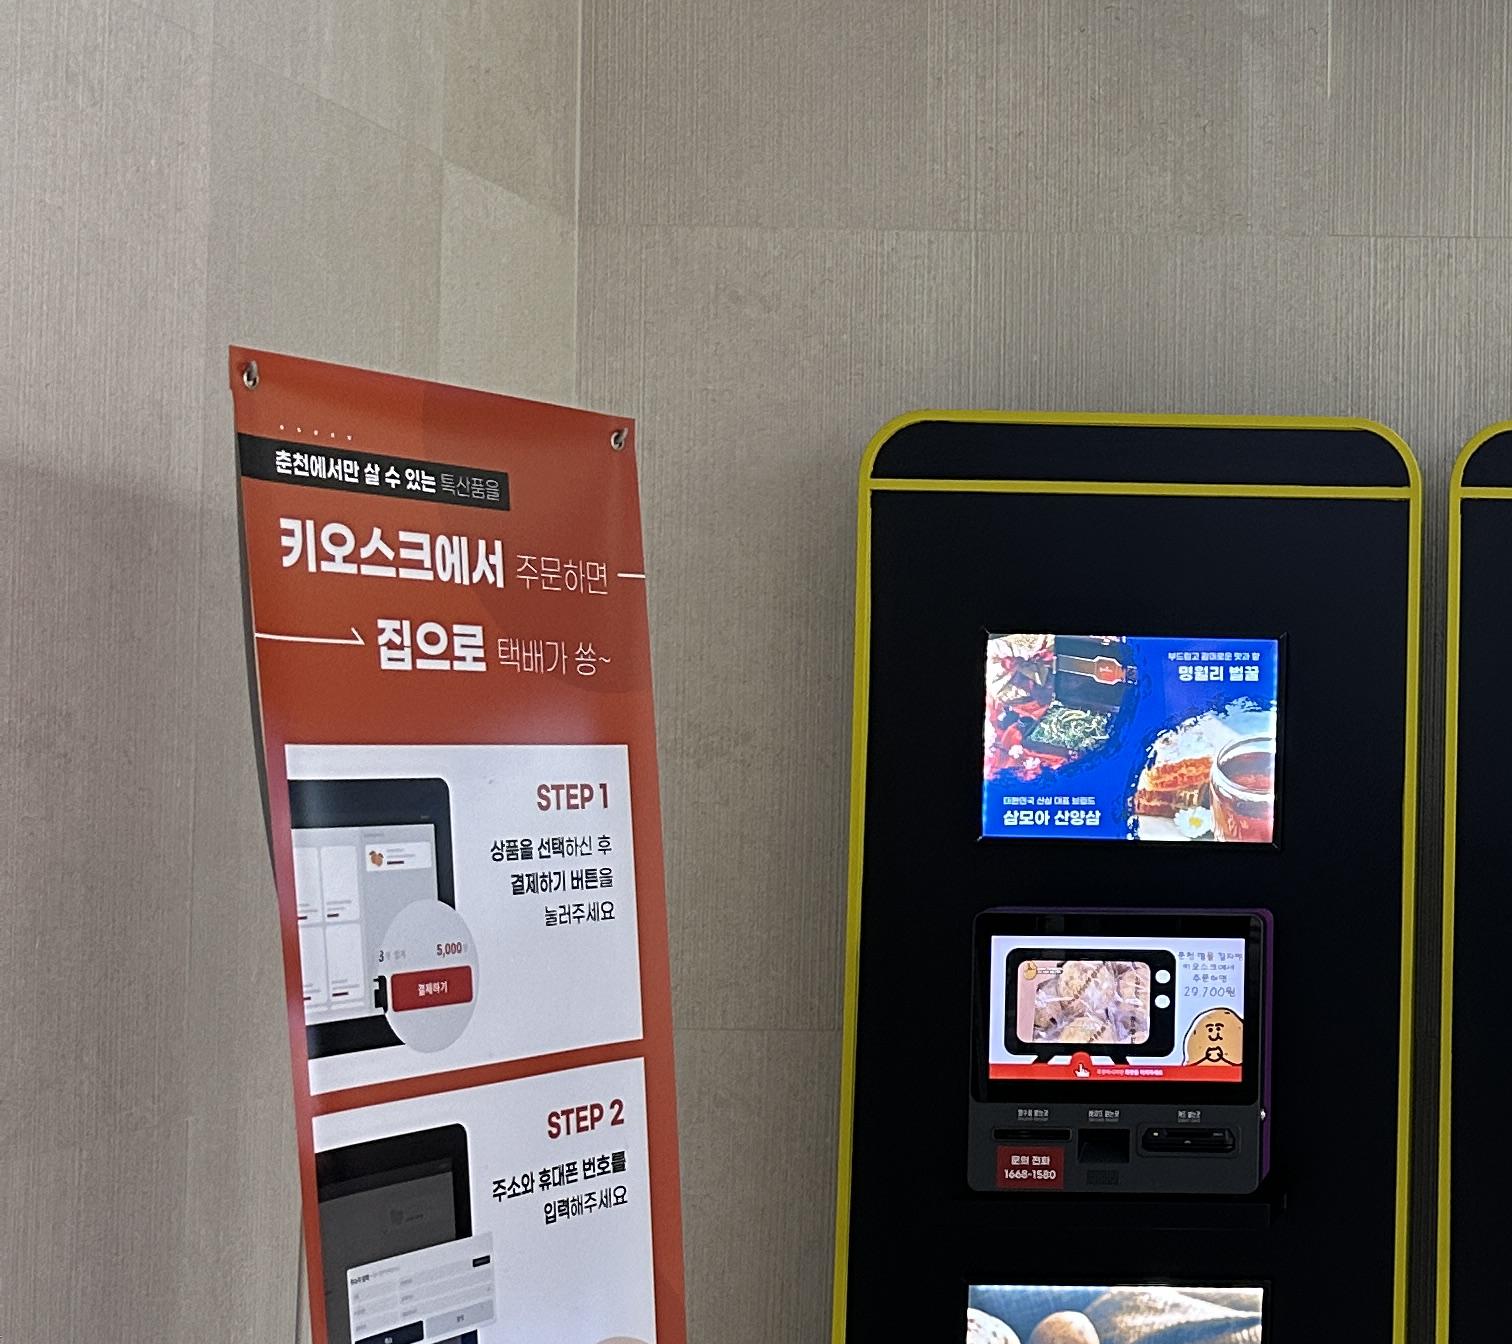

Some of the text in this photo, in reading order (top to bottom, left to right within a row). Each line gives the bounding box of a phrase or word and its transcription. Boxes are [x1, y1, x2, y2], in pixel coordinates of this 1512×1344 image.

[275, 449, 501, 502] 춘천에서만 살 수 있는 특산품을
[279, 517, 609, 595] 키오스크에서 주문하면
[376, 618, 611, 676] 집으로 택배가 쑝~
[1178, 665, 1260, 682] 명월리 벌꿀
[536, 782, 609, 811] STEP 1
[1003, 809, 1102, 826] 삼모아 산양삼
[490, 834, 613, 862] 상품을 선택하신 후
[510, 867, 614, 895] 결제하기 버튼을
[544, 900, 615, 927] 눌러주세요
[436, 942, 463, 958] 5,000
[418, 981, 448, 996] 결제하기
[547, 1098, 625, 1139] STEP 2
[1004, 1169, 1056, 1179] 1668-1580
[1011, 1155, 1050, 1165] 문의 전화
[491, 1150, 627, 1203] 주소와 휴대폰 번호를
[543, 1185, 628, 1225] 입력해주세요
